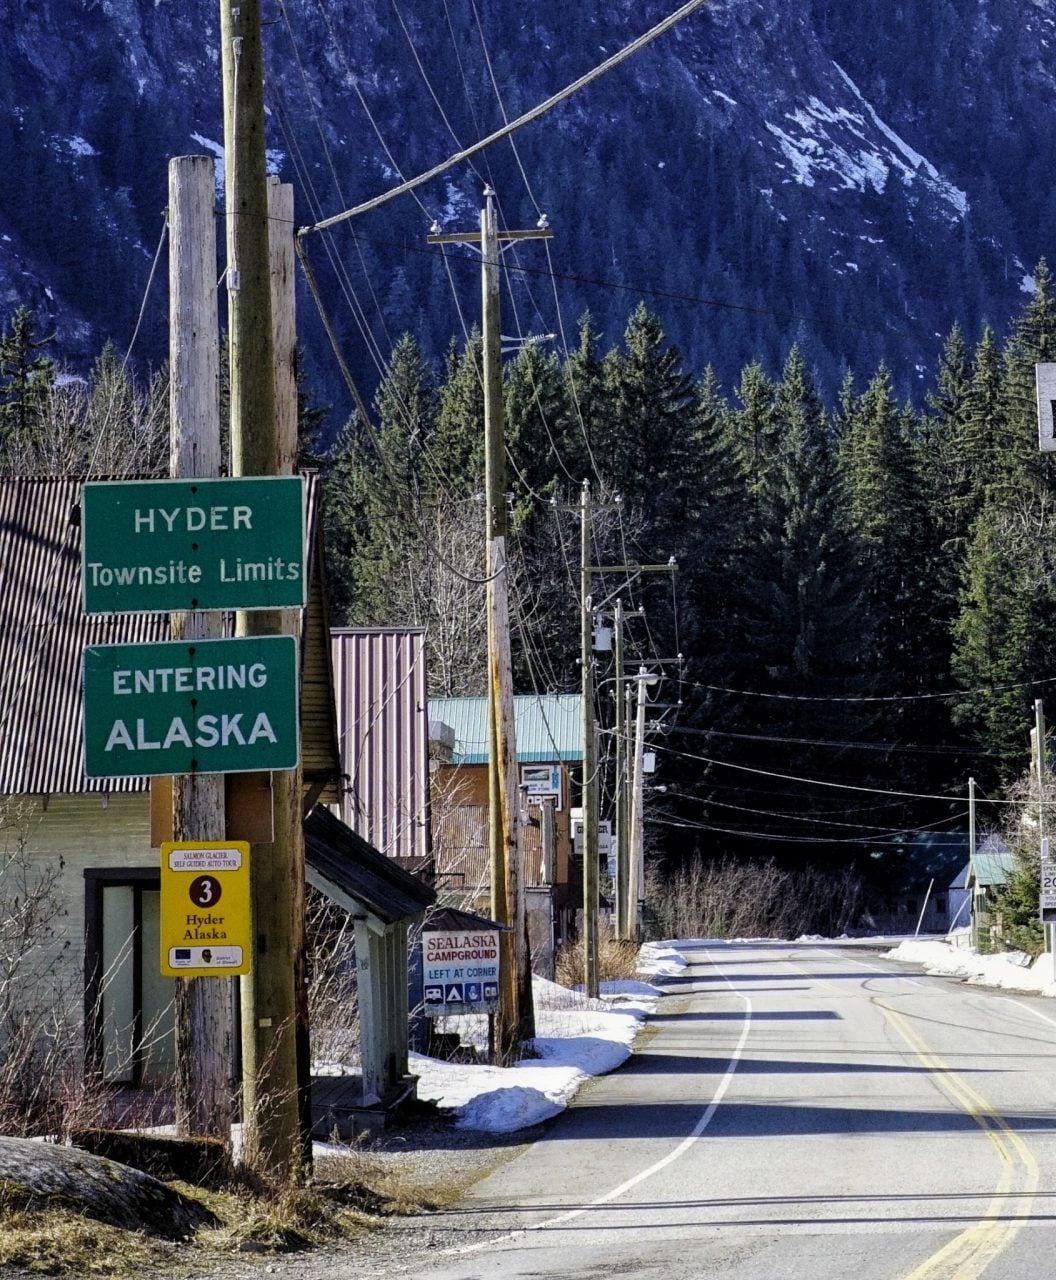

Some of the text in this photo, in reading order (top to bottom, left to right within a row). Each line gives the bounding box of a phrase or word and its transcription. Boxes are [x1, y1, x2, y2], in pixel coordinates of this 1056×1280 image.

[134, 506, 253, 533] HYDER
[87, 556, 300, 587] Townsite Limits
[113, 663, 268, 695] ENTERING
[104, 712, 278, 752] ALASKA
[184, 851, 228, 860] SALMON GLACIER
[174, 860, 186, 868] SELF
[222, 859, 237, 867] TOUR
[199, 880, 213, 903] 3
[186, 913, 225, 928] Hyder
[183, 928, 227, 940] Alaska
[427, 935, 497, 951] SEALASKA
[427, 950, 497, 961] CAMPGROUND
[429, 967, 497, 980] LEFT AT CORNER
